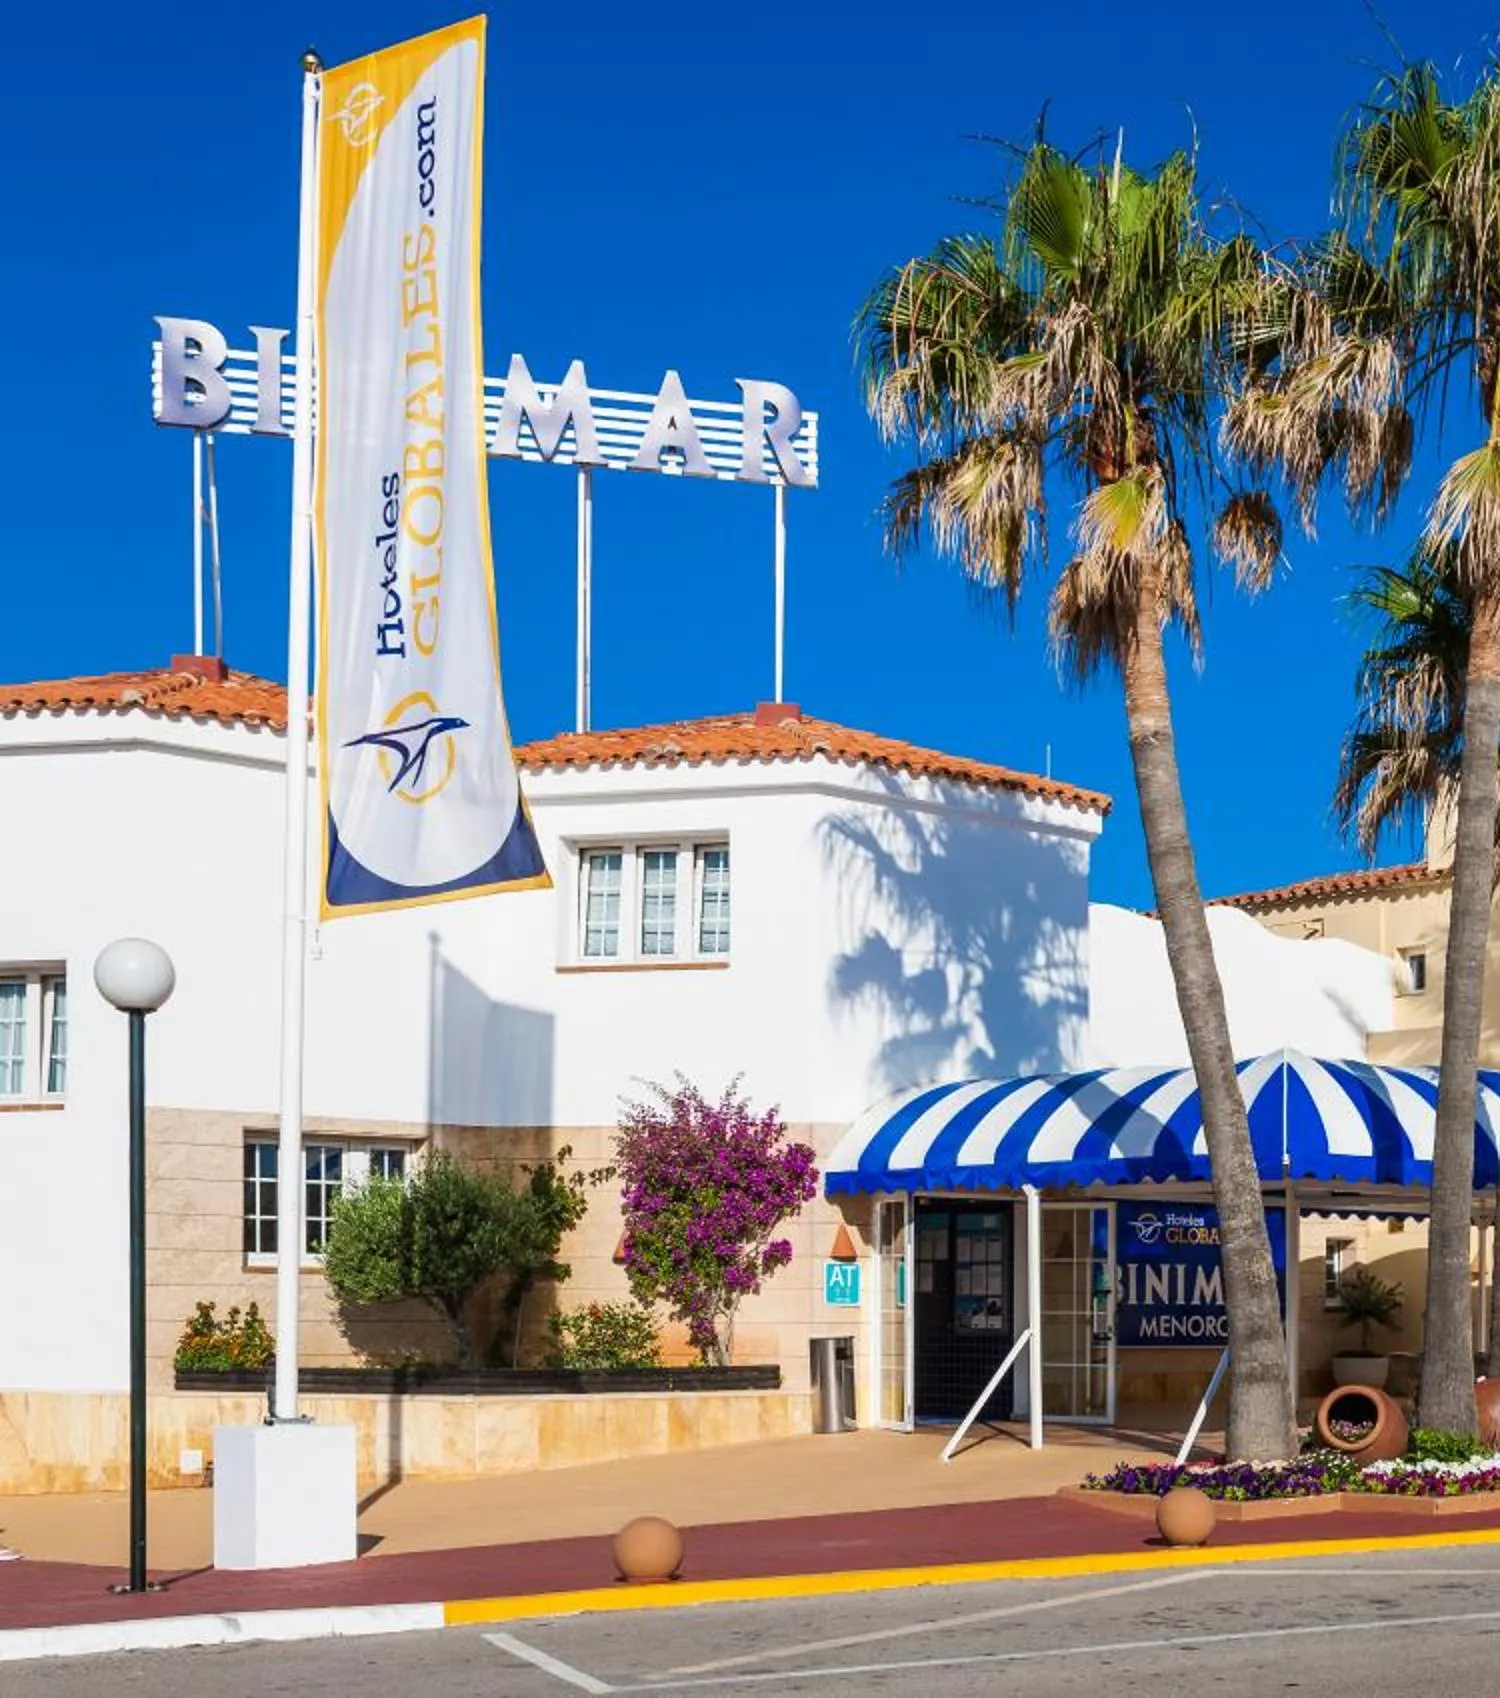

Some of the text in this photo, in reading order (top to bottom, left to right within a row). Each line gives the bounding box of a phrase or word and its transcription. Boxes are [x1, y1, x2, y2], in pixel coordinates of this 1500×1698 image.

[153, 315, 811, 487] BIMAR
[376, 472, 406, 659] Hoteles
[1165, 1227, 1221, 1244] GLOBA
[829, 1265, 857, 1287] AT
[1103, 1263, 1226, 1305] BINIM
[1139, 1315, 1230, 1338] MENORC
